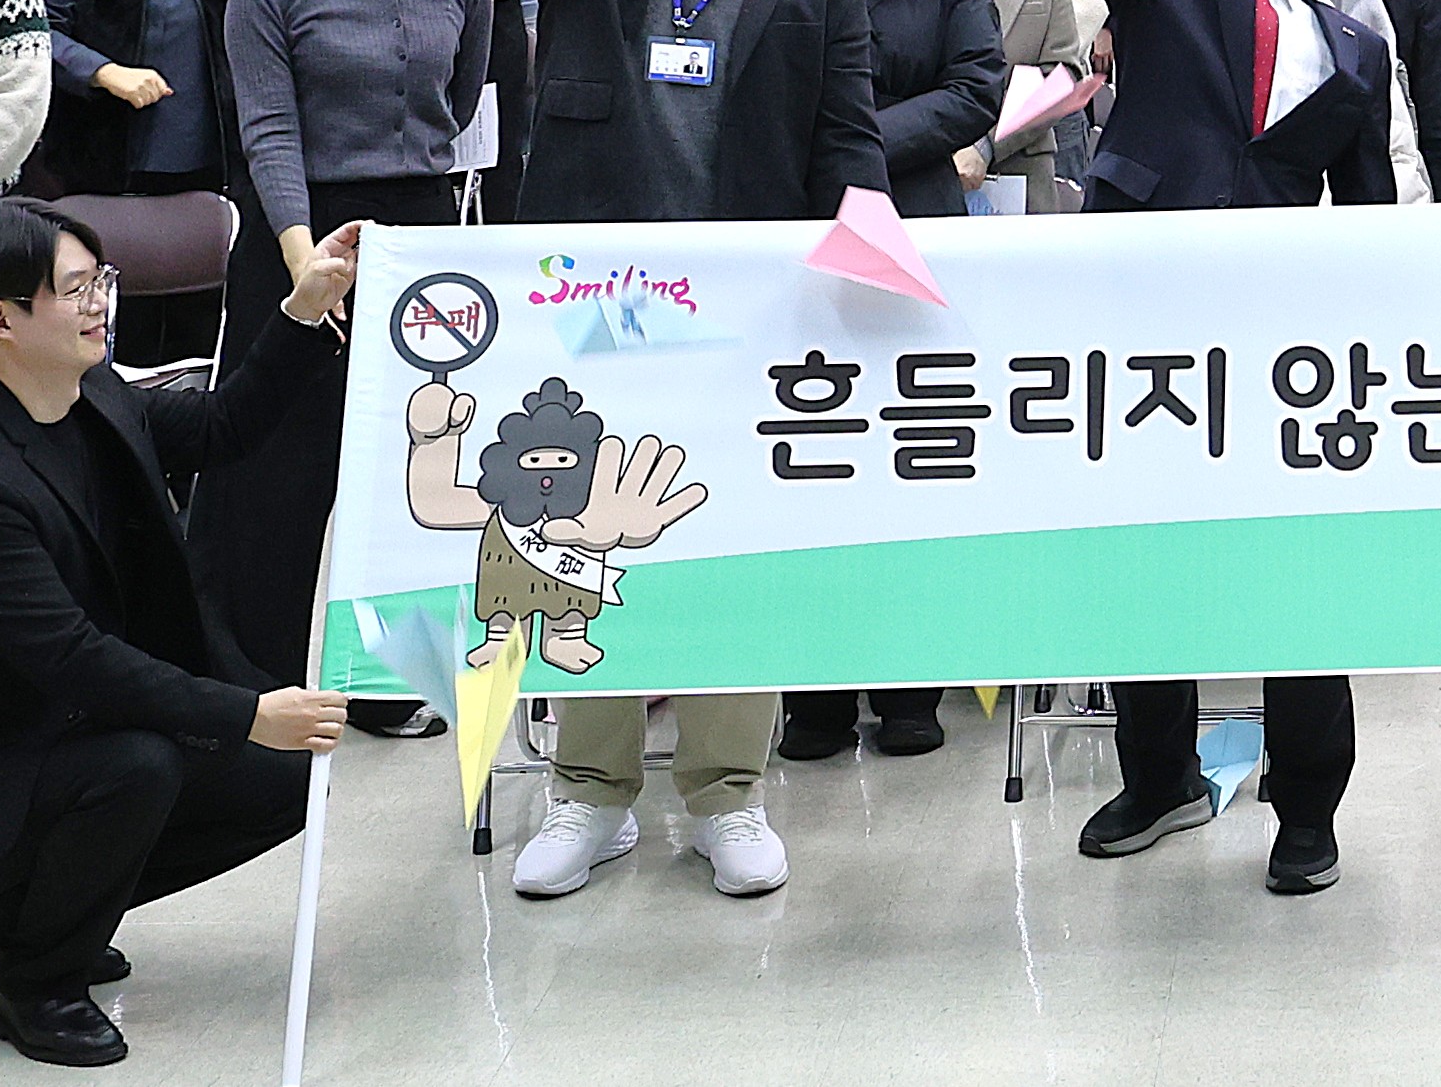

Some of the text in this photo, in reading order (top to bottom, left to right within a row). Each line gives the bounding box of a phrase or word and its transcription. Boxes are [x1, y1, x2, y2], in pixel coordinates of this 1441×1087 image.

[528, 253, 697, 317] Smiling
[403, 301, 481, 341] 부패
[757, 348, 1227, 480] 흔들리지
